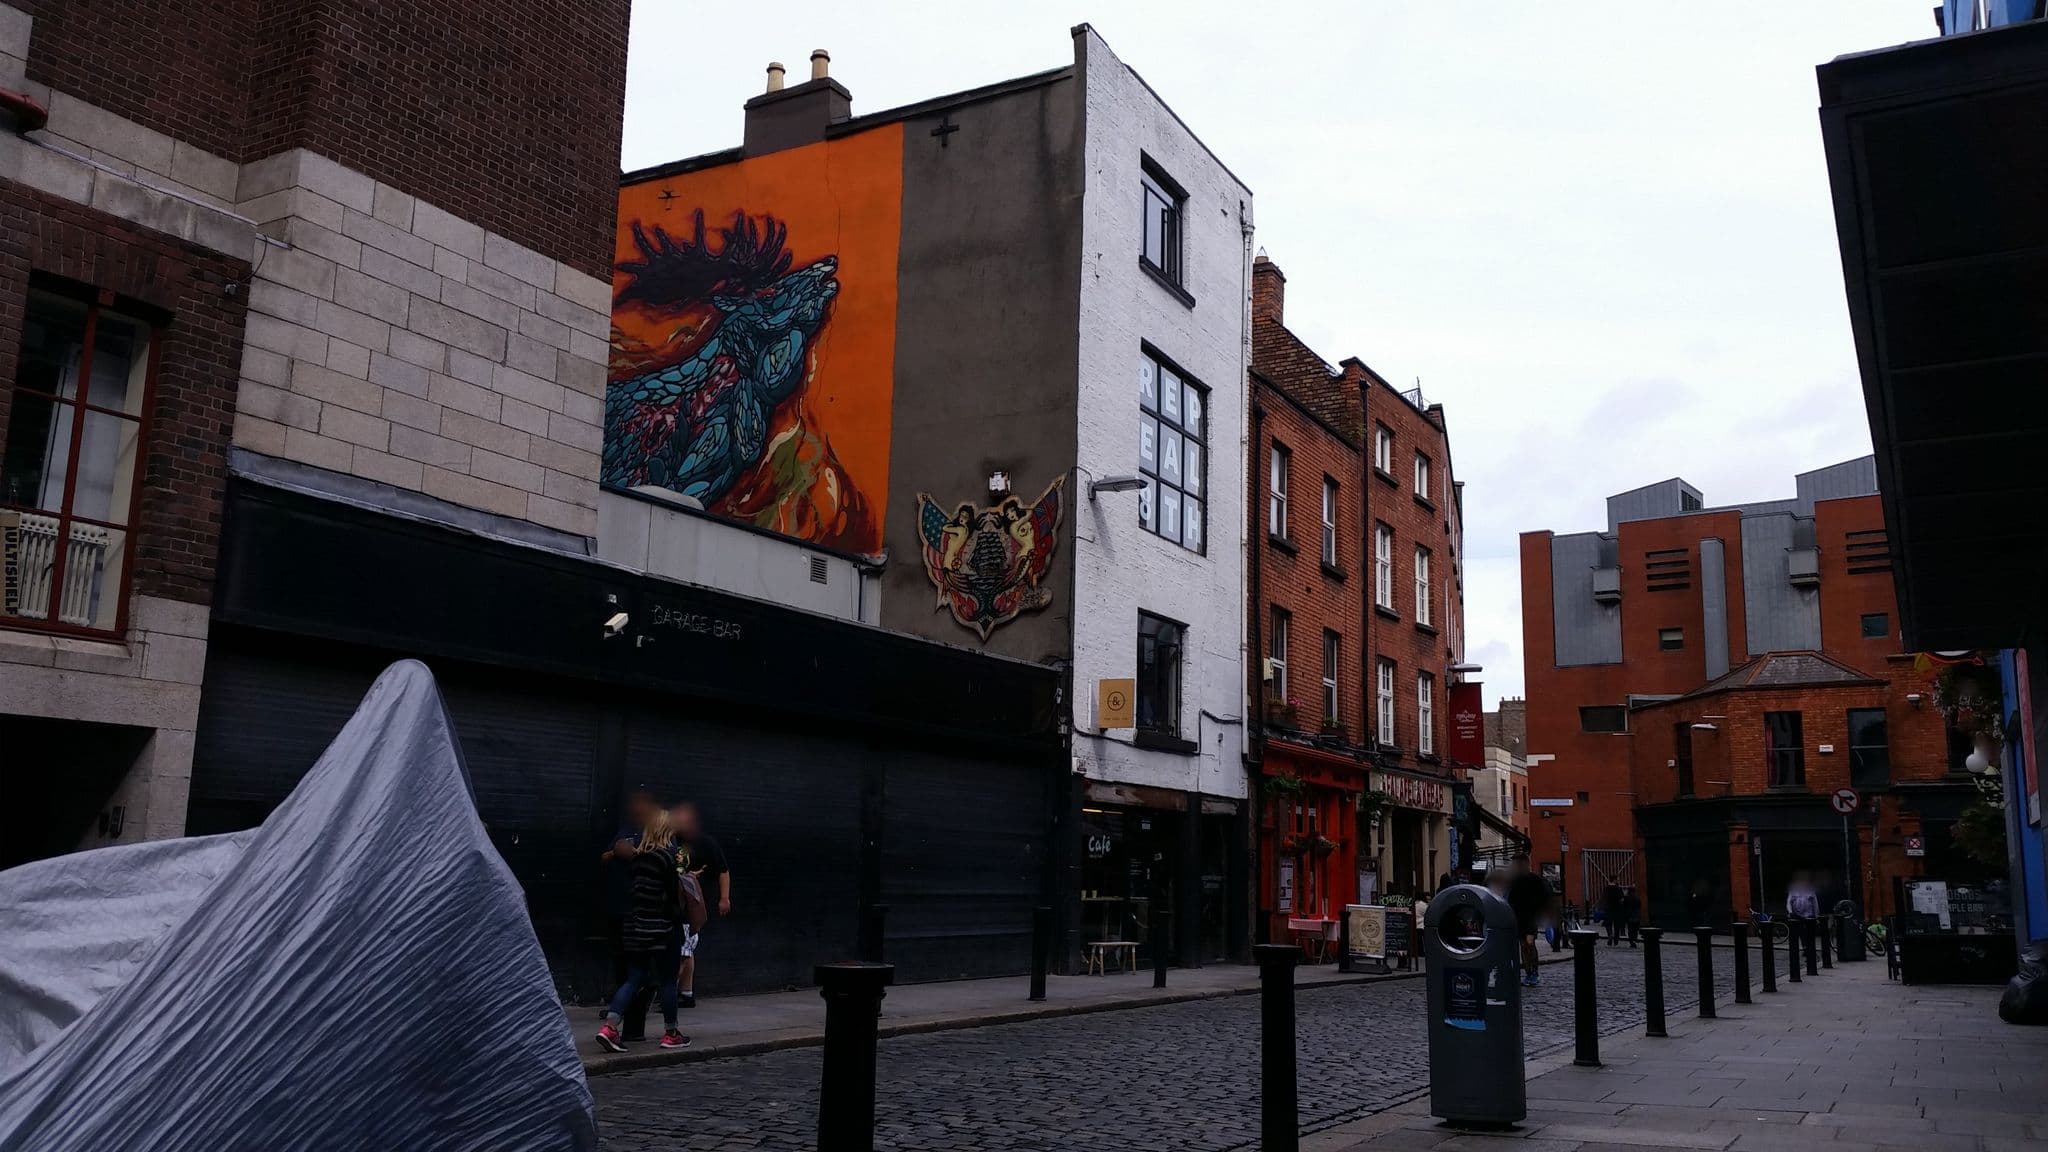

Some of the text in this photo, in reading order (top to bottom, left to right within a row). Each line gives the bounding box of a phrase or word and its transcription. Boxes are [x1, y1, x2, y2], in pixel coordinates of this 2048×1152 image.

[5, 527, 18, 615] ULTISHELF
[652, 604, 742, 641] GARAGE BAR
[1088, 835, 1112, 855] Café
